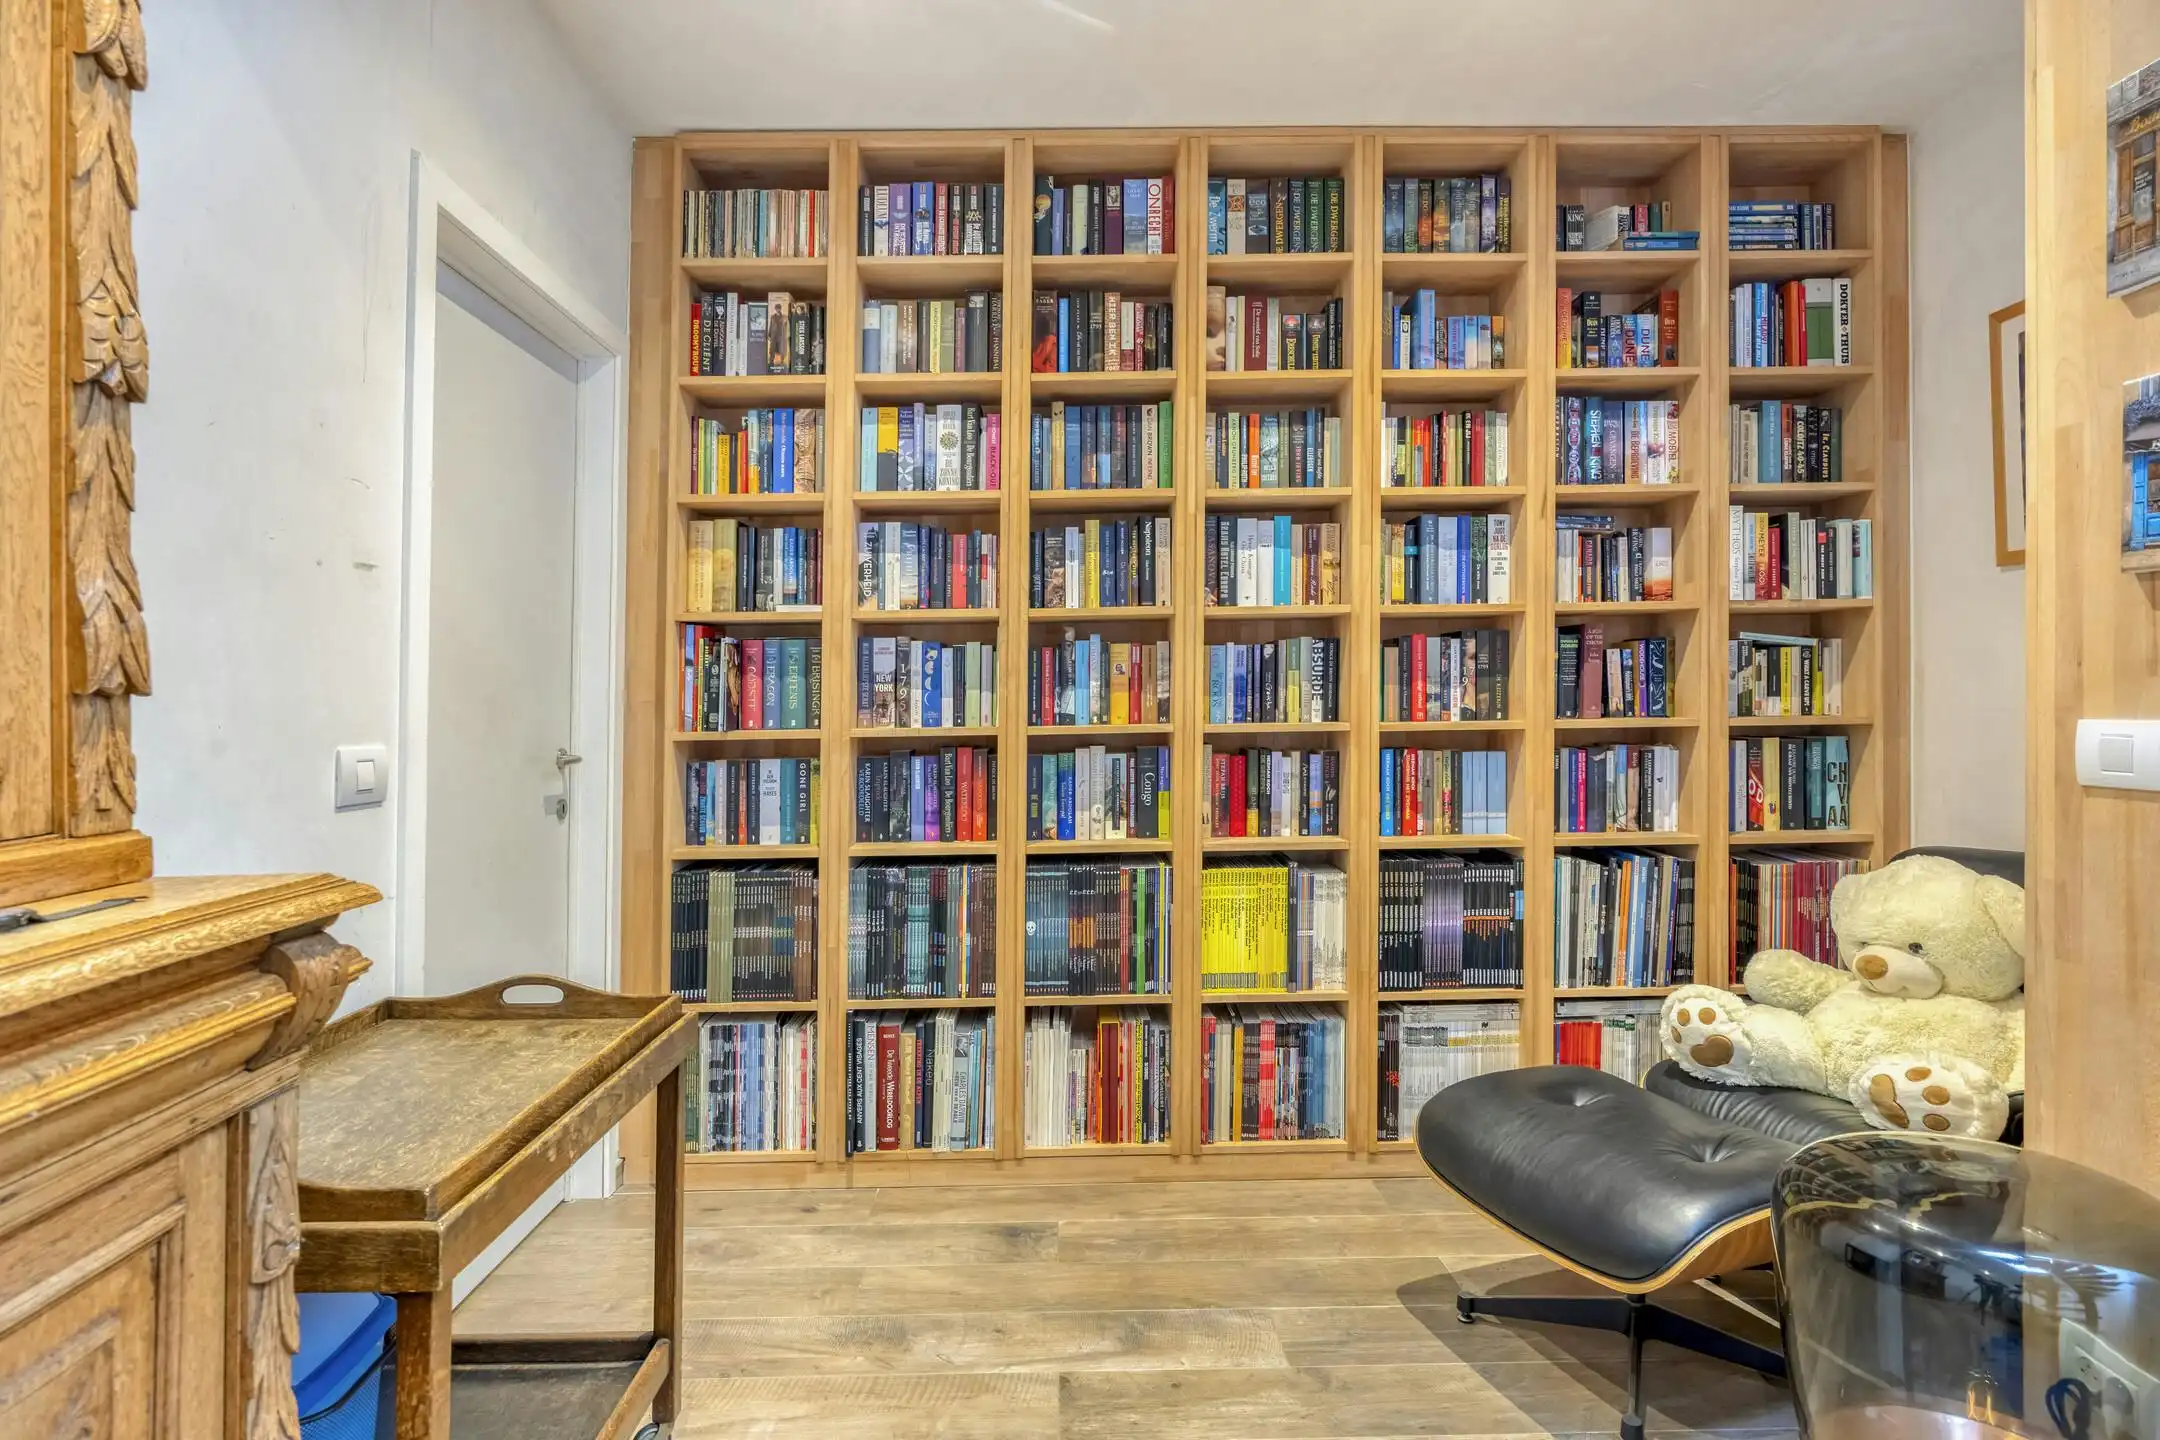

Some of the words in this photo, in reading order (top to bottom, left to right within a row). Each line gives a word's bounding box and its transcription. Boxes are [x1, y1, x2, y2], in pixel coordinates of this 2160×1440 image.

[1149, 184, 1161, 236] ONRECHT
[1208, 196, 1218, 207] De
[1294, 193, 1301, 203] DE
[1311, 193, 1319, 204] DE
[1330, 193, 1338, 204] DE
[1208, 211, 1219, 242] Zwerm
[1294, 206, 1302, 248] DWERGEN
[1311, 206, 1319, 248] DWERGEN
[1330, 206, 1338, 248] DWERGEN
[1108, 296, 1116, 320] HIER
[1840, 284, 1848, 326] DOKTER
[703, 320, 711, 333] DE
[1108, 322, 1116, 342] BEN
[1108, 342, 1116, 356] IK
[1625, 331, 1635, 363] DUNE
[1641, 329, 1651, 363] DUNE
[1841, 332, 1850, 364] THUIS
[1591, 410, 1602, 448] STEPHEN
[1668, 431, 1677, 462] MOBIEL
[1590, 456, 1602, 480] KING
[1144, 521, 1153, 556] Napoleon
[1732, 510, 1742, 555] MYTHOS
[1585, 540, 1593, 565] CANADA
[863, 541, 873, 598] ZUIVERHEID
[876, 673, 892, 683] NEW
[1312, 638, 1323, 701] ABSURDE
[766, 666, 776, 706] ERAGON
[874, 683, 894, 693] YORK
[944, 754, 953, 765] Bart
[799, 763, 807, 789] GONE
[1141, 772, 1156, 806] Congo
[799, 793, 807, 813] GIRL
[867, 1025, 875, 1061] MENSEN
[887, 1050, 895, 1060] De
[886, 1060, 895, 1081] Tweede
[925, 1049, 935, 1086] Naked
[960, 1071, 968, 1098] CHARLES
[886, 1081, 895, 1129] WERELDOORLOG
[958, 1099, 967, 1123] DARWIN
